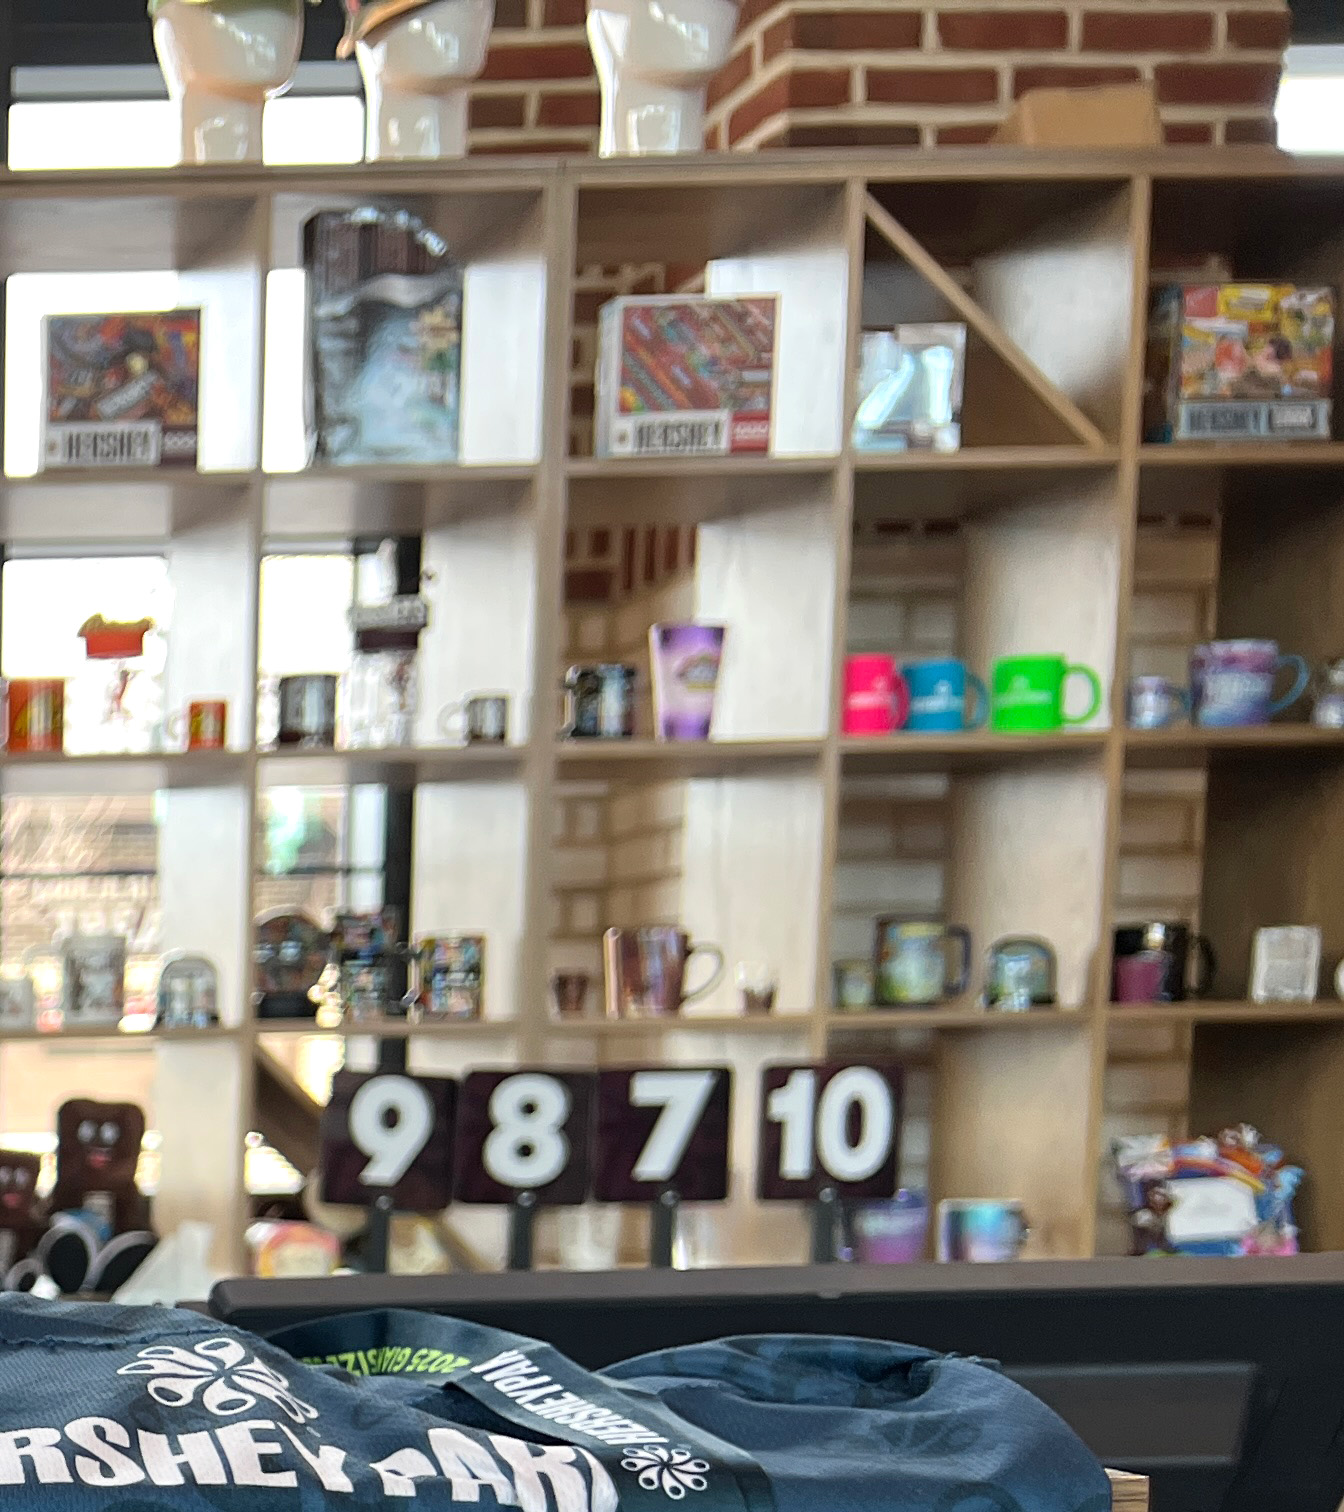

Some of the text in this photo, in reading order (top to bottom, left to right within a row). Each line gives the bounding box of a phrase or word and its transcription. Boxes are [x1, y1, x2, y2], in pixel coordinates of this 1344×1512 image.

[351, 1073, 435, 1188] 9
[482, 1072, 570, 1188] 8
[629, 1070, 718, 1183] 7
[766, 1065, 896, 1184] 10
